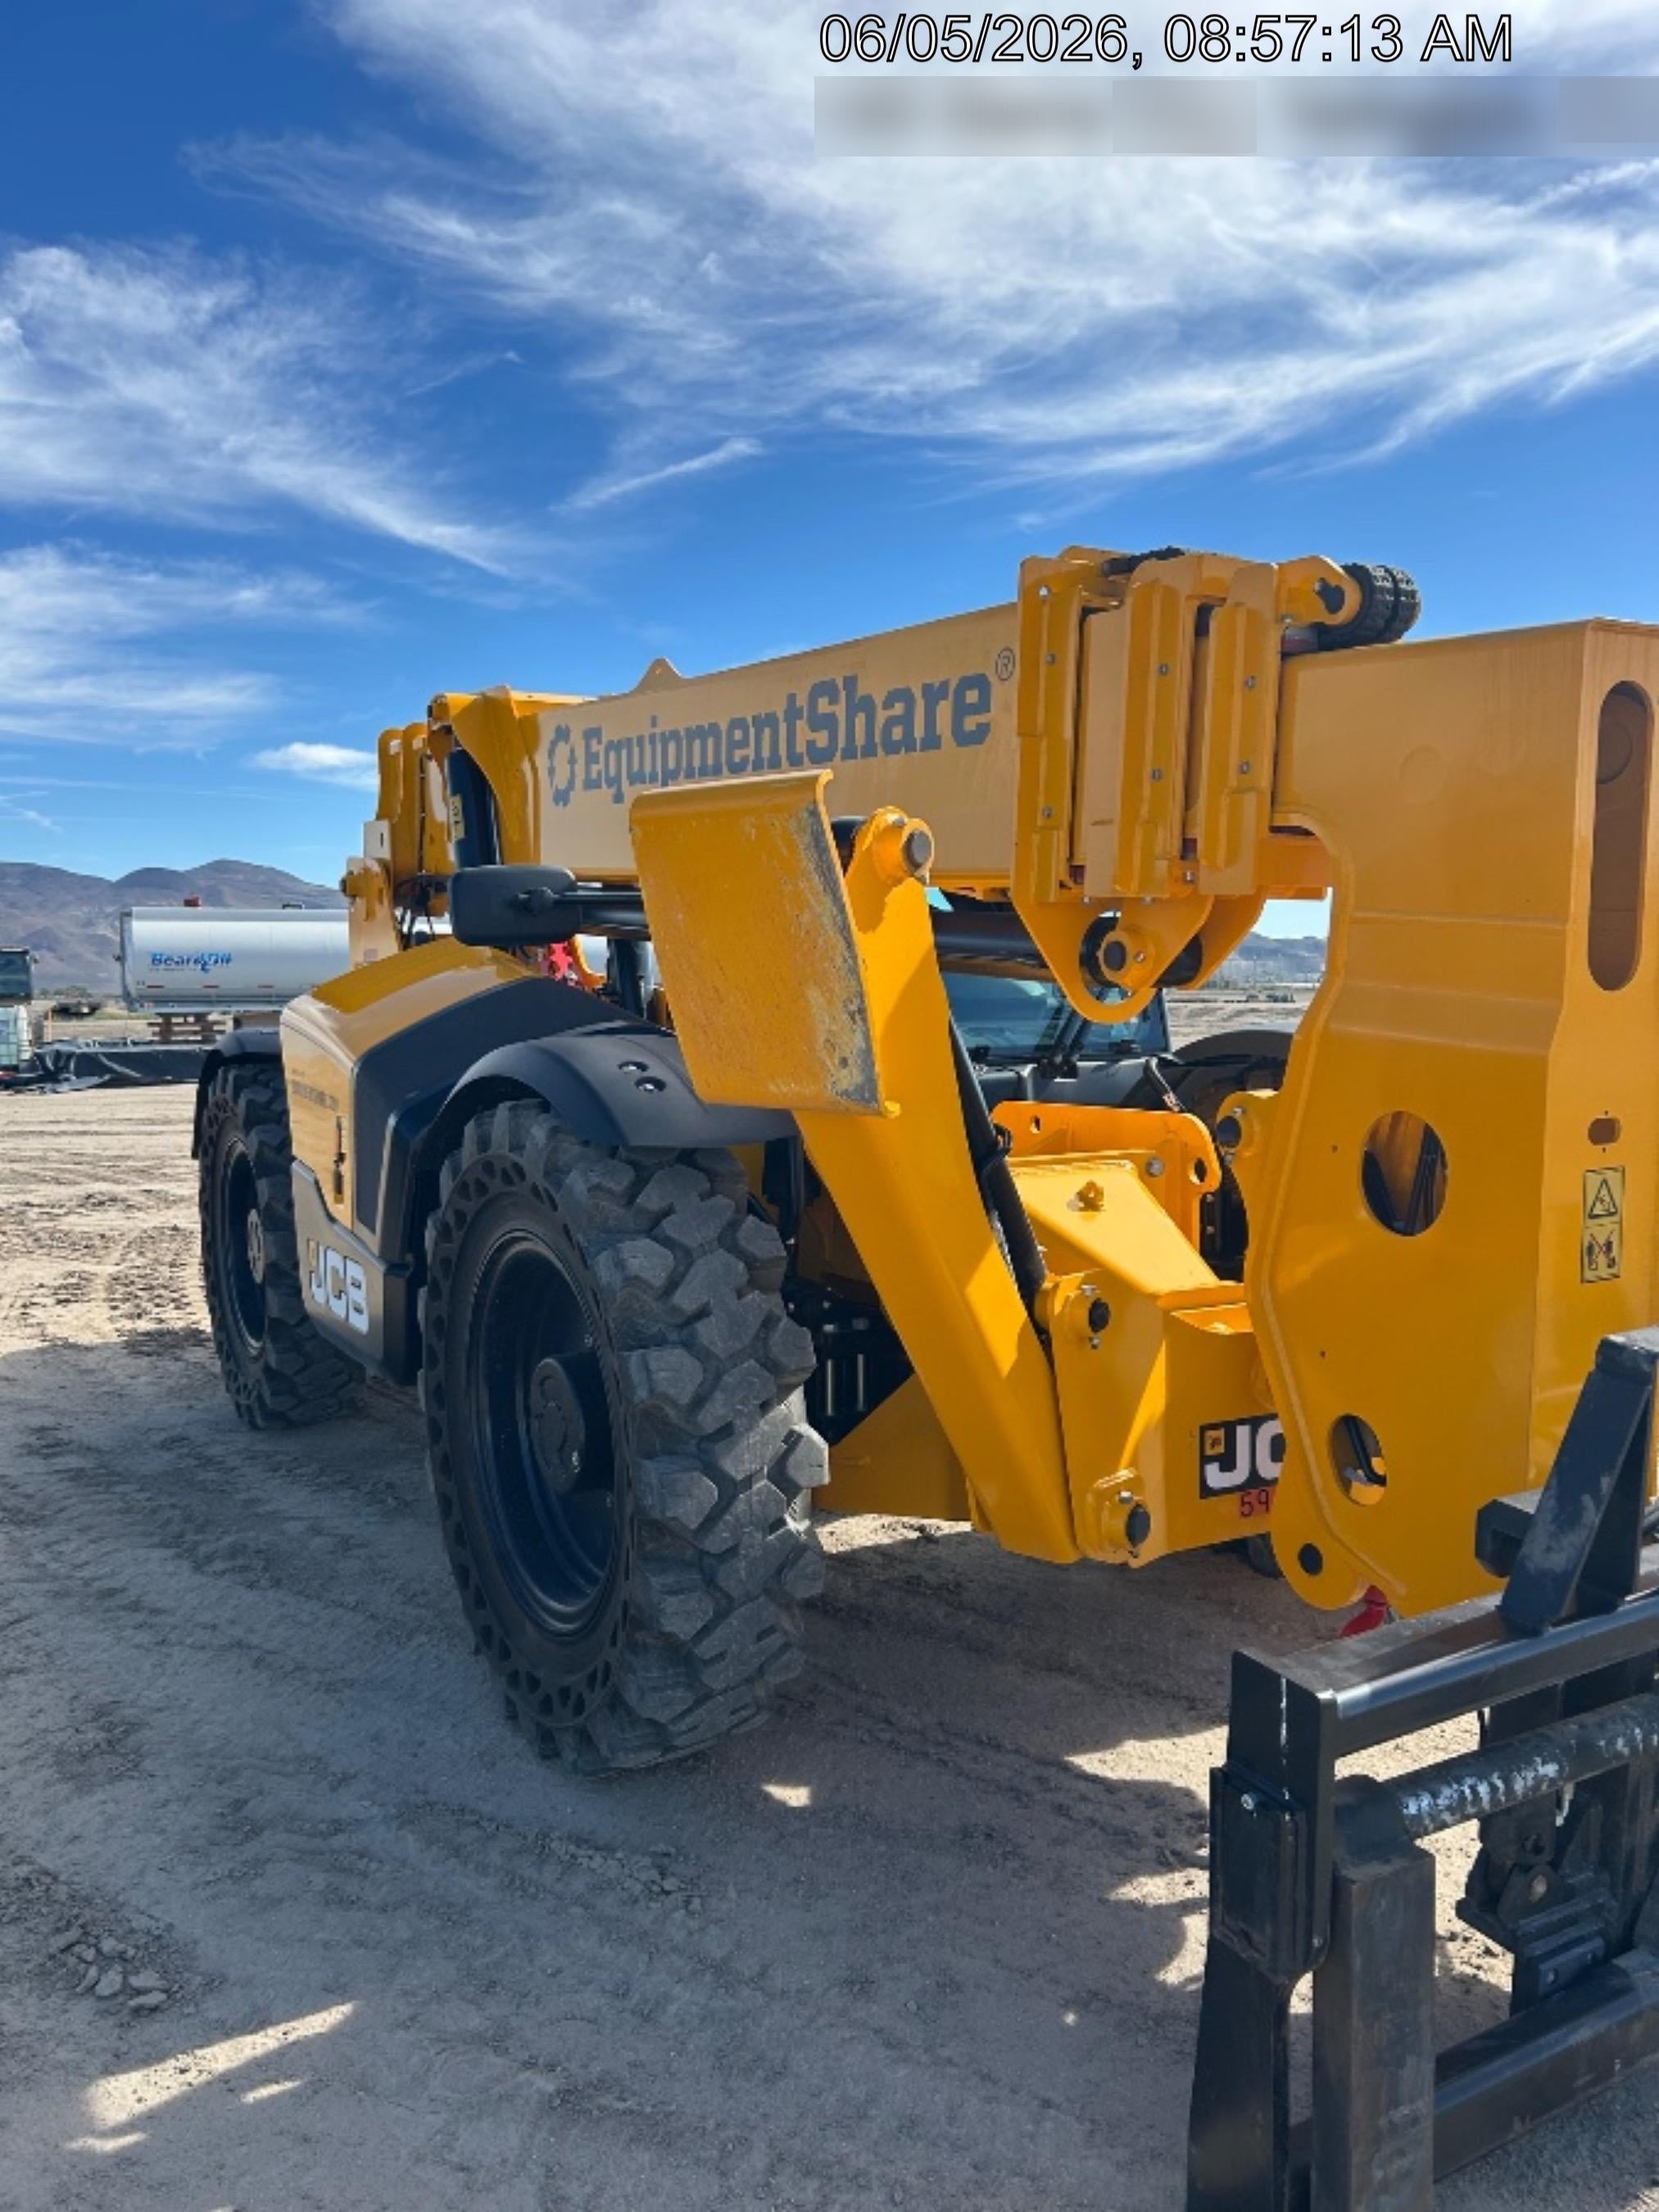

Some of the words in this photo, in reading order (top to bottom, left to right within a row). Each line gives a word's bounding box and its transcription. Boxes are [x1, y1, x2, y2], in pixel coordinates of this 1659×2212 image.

[582, 673, 992, 805] EquipmentShare
[310, 1244, 369, 1335] JCB
[1204, 1420, 1285, 1489] JC
